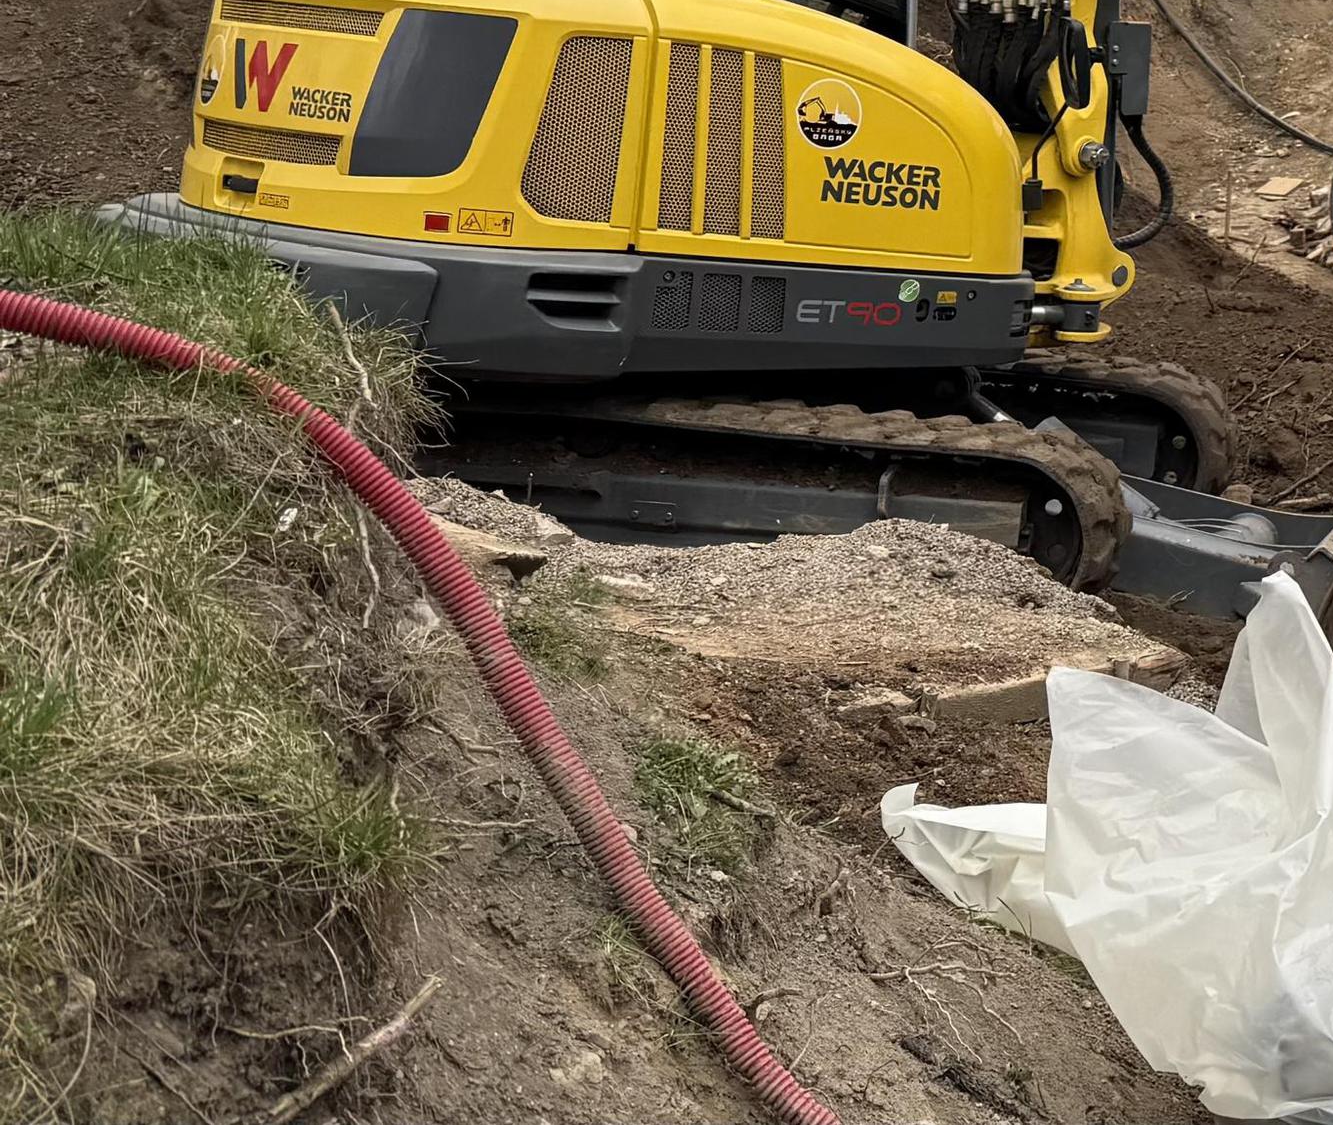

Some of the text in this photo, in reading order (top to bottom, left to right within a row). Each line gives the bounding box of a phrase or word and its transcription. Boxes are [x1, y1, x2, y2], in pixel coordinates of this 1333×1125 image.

[291, 86, 352, 108] WACKER
[288, 102, 352, 123] NEUSON
[823, 155, 941, 188] WACKER
[820, 179, 941, 211] NEUSON
[796, 299, 902, 326] ET90
